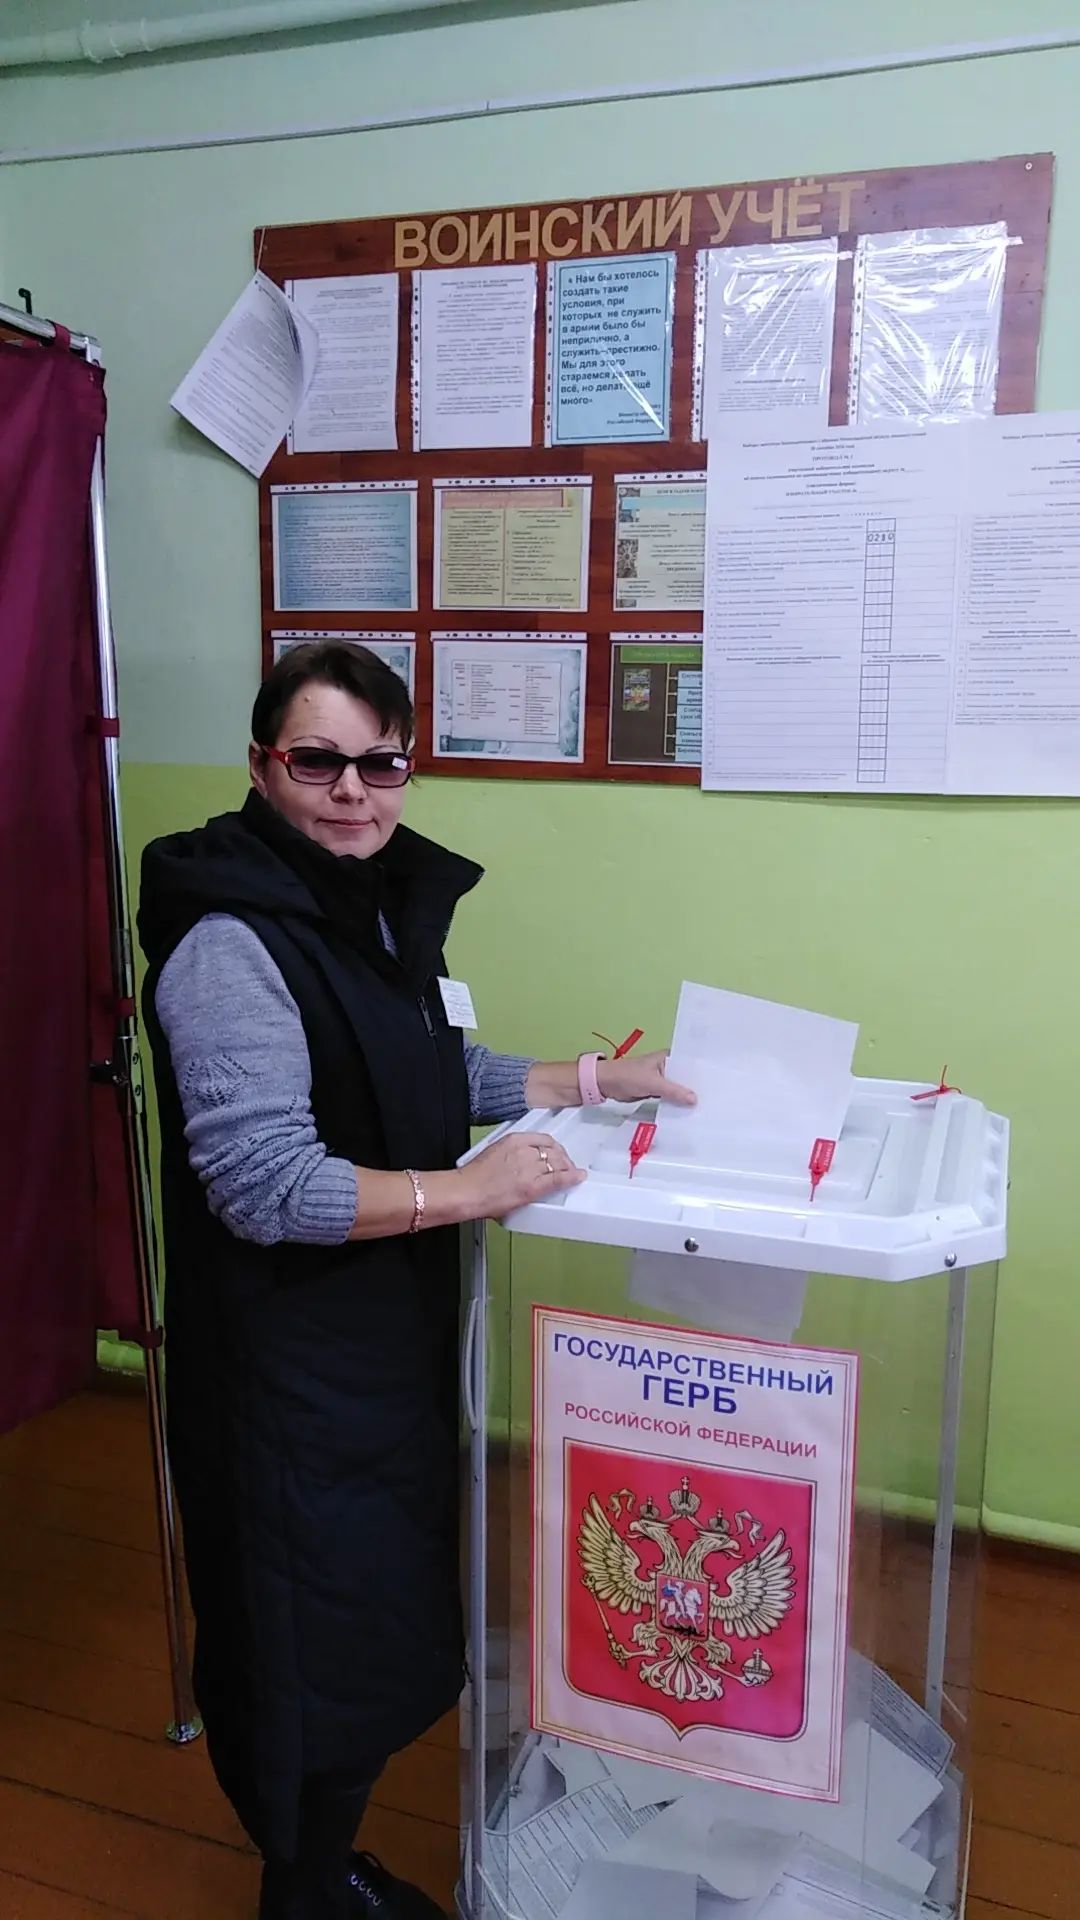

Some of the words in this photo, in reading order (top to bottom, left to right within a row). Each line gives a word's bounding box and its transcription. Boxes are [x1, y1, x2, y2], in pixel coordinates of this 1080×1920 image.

[394, 191, 692, 268] ВОИНСКИЙ
[706, 178, 866, 244] УЧЁТ
[576, 274, 595, 283] Нам
[597, 272, 612, 282] бы
[614, 270, 660, 280] хотелось
[562, 286, 600, 297] создать
[603, 284, 629, 294] такие
[562, 298, 604, 311] условия,
[607, 297, 624, 307] при
[562, 312, 602, 322] которых
[621, 307, 662, 320] служить
[570, 324, 600, 335] армии
[602, 321, 629, 330] было
[631, 320, 646, 328] бы
[562, 360, 577, 370] Мы
[579, 360, 598, 369] для
[560, 372, 610, 383] стараемся
[560, 384, 580, 394] всё,
[582, 384, 594, 392] но
[596, 384, 628, 392] делат
[554, 1333, 833, 1396] ГОСУДАРСТВЕННЫЙ
[643, 1374, 737, 1415] ГЕРБ
[564, 1402, 690, 1438] РОССИЙСКОЙ
[697, 1427, 817, 1458] ФЕДЕРАЦИИ
